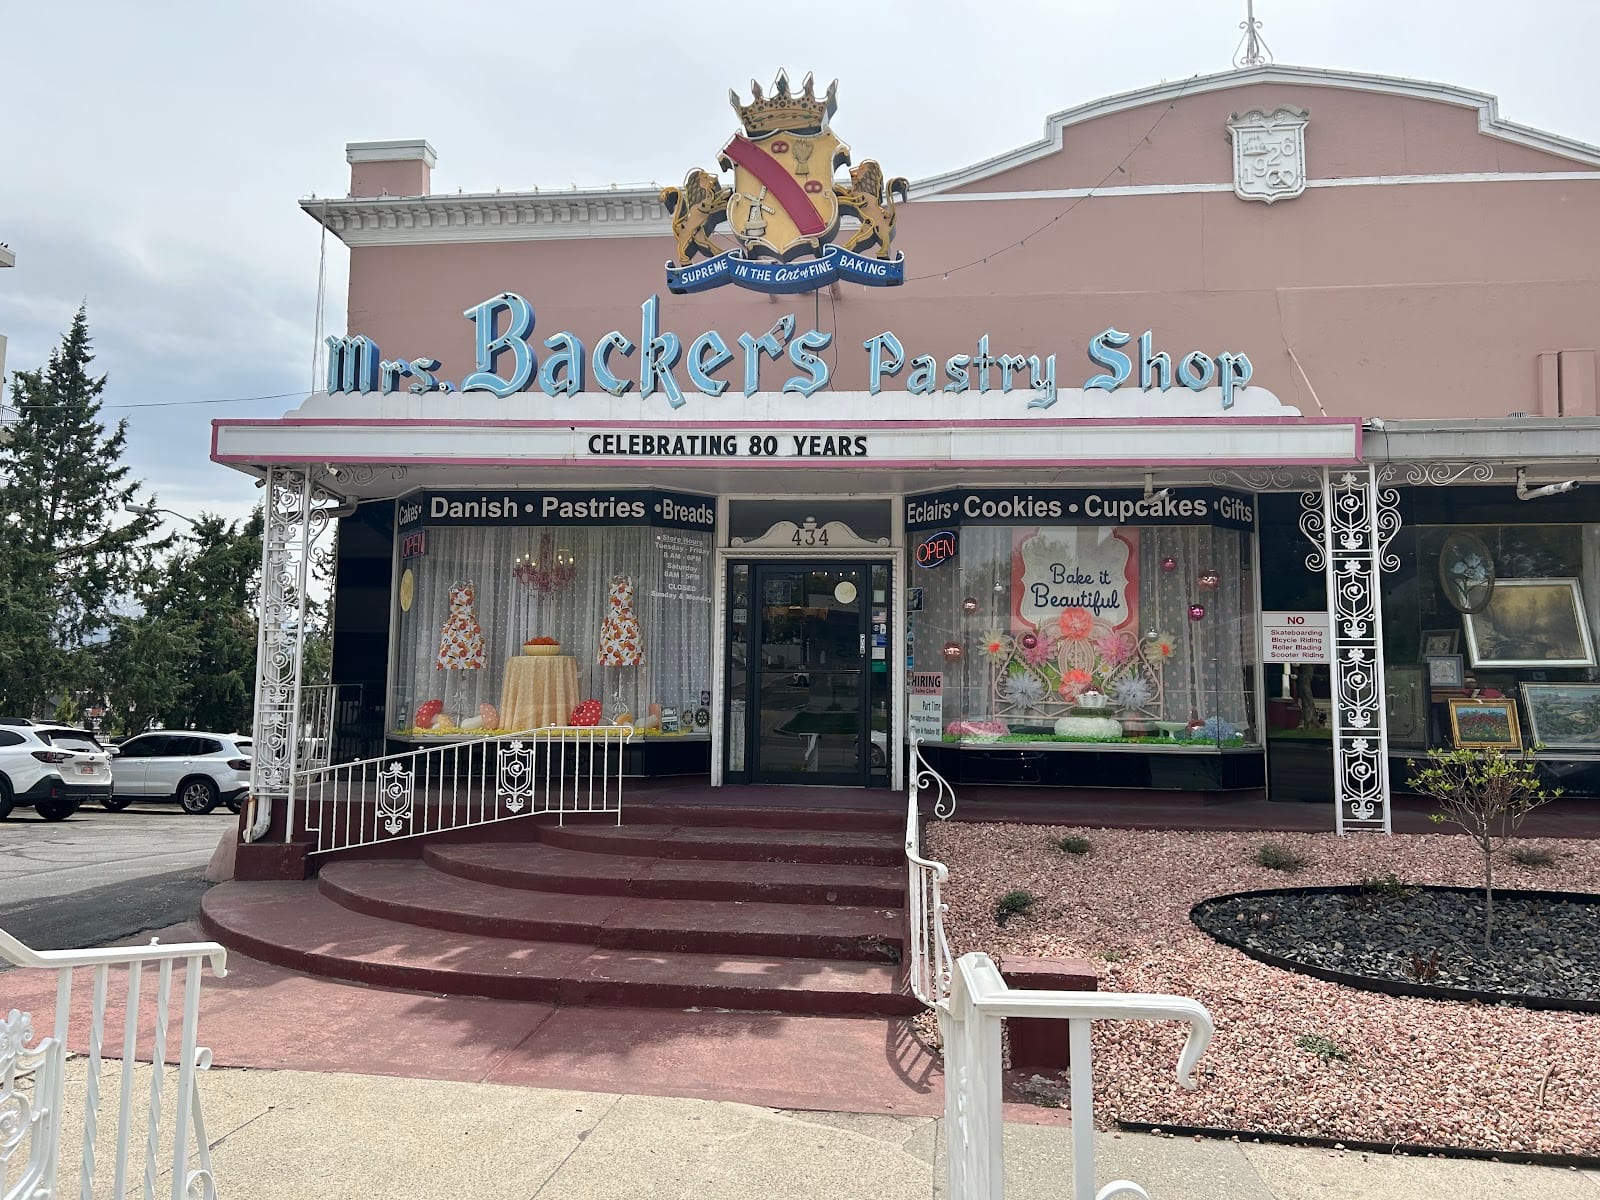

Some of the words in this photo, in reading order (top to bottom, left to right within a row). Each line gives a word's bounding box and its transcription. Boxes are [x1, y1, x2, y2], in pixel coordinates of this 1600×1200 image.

[681, 258, 729, 284] SUPREME
[735, 264, 747, 278] IN
[750, 267, 771, 281] THE
[800, 269, 809, 280] of
[808, 259, 834, 278] FINE
[839, 254, 887, 276] BAKING
[325, 333, 456, 396] Mrs.
[461, 292, 834, 409] Backer's
[863, 330, 1058, 409] Pastry
[1083, 326, 1254, 410] Shop
[587, 434, 738, 457] CELEBRATING
[748, 434, 778, 457] 80
[793, 435, 868, 457] YEARS
[399, 503, 418, 526] Cakes
[430, 496, 518, 518] Danish
[542, 496, 646, 518] Pastries
[662, 498, 714, 525] Breads
[907, 502, 952, 524] Eclairs
[963, 495, 1062, 518] Cookies
[1084, 495, 1208, 522] Cupcakes
[1219, 496, 1253, 522] Gifts
[402, 531, 425, 557] OPEN
[662, 534, 682, 543] Store
[683, 538, 703, 546] Hours
[791, 529, 829, 546] 434
[655, 542, 684, 552] Tuesday
[689, 547, 710, 556] Friday
[669, 552, 681, 560] AM
[916, 537, 955, 563] OPEN
[667, 562, 698, 573] Saturday
[1050, 563, 1093, 585] Bake
[1099, 570, 1112, 585] it
[651, 590, 677, 600] Sunday
[686, 593, 712, 603] Monday
[668, 583, 697, 592] CLOSED
[1030, 582, 1121, 616] Beautiful
[1287, 616, 1305, 625] NO
[1270, 629, 1323, 637] Skateboarding
[1295, 644, 1322, 652] Blading
[1302, 651, 1324, 659] Riding
[912, 675, 941, 688] HIRING
